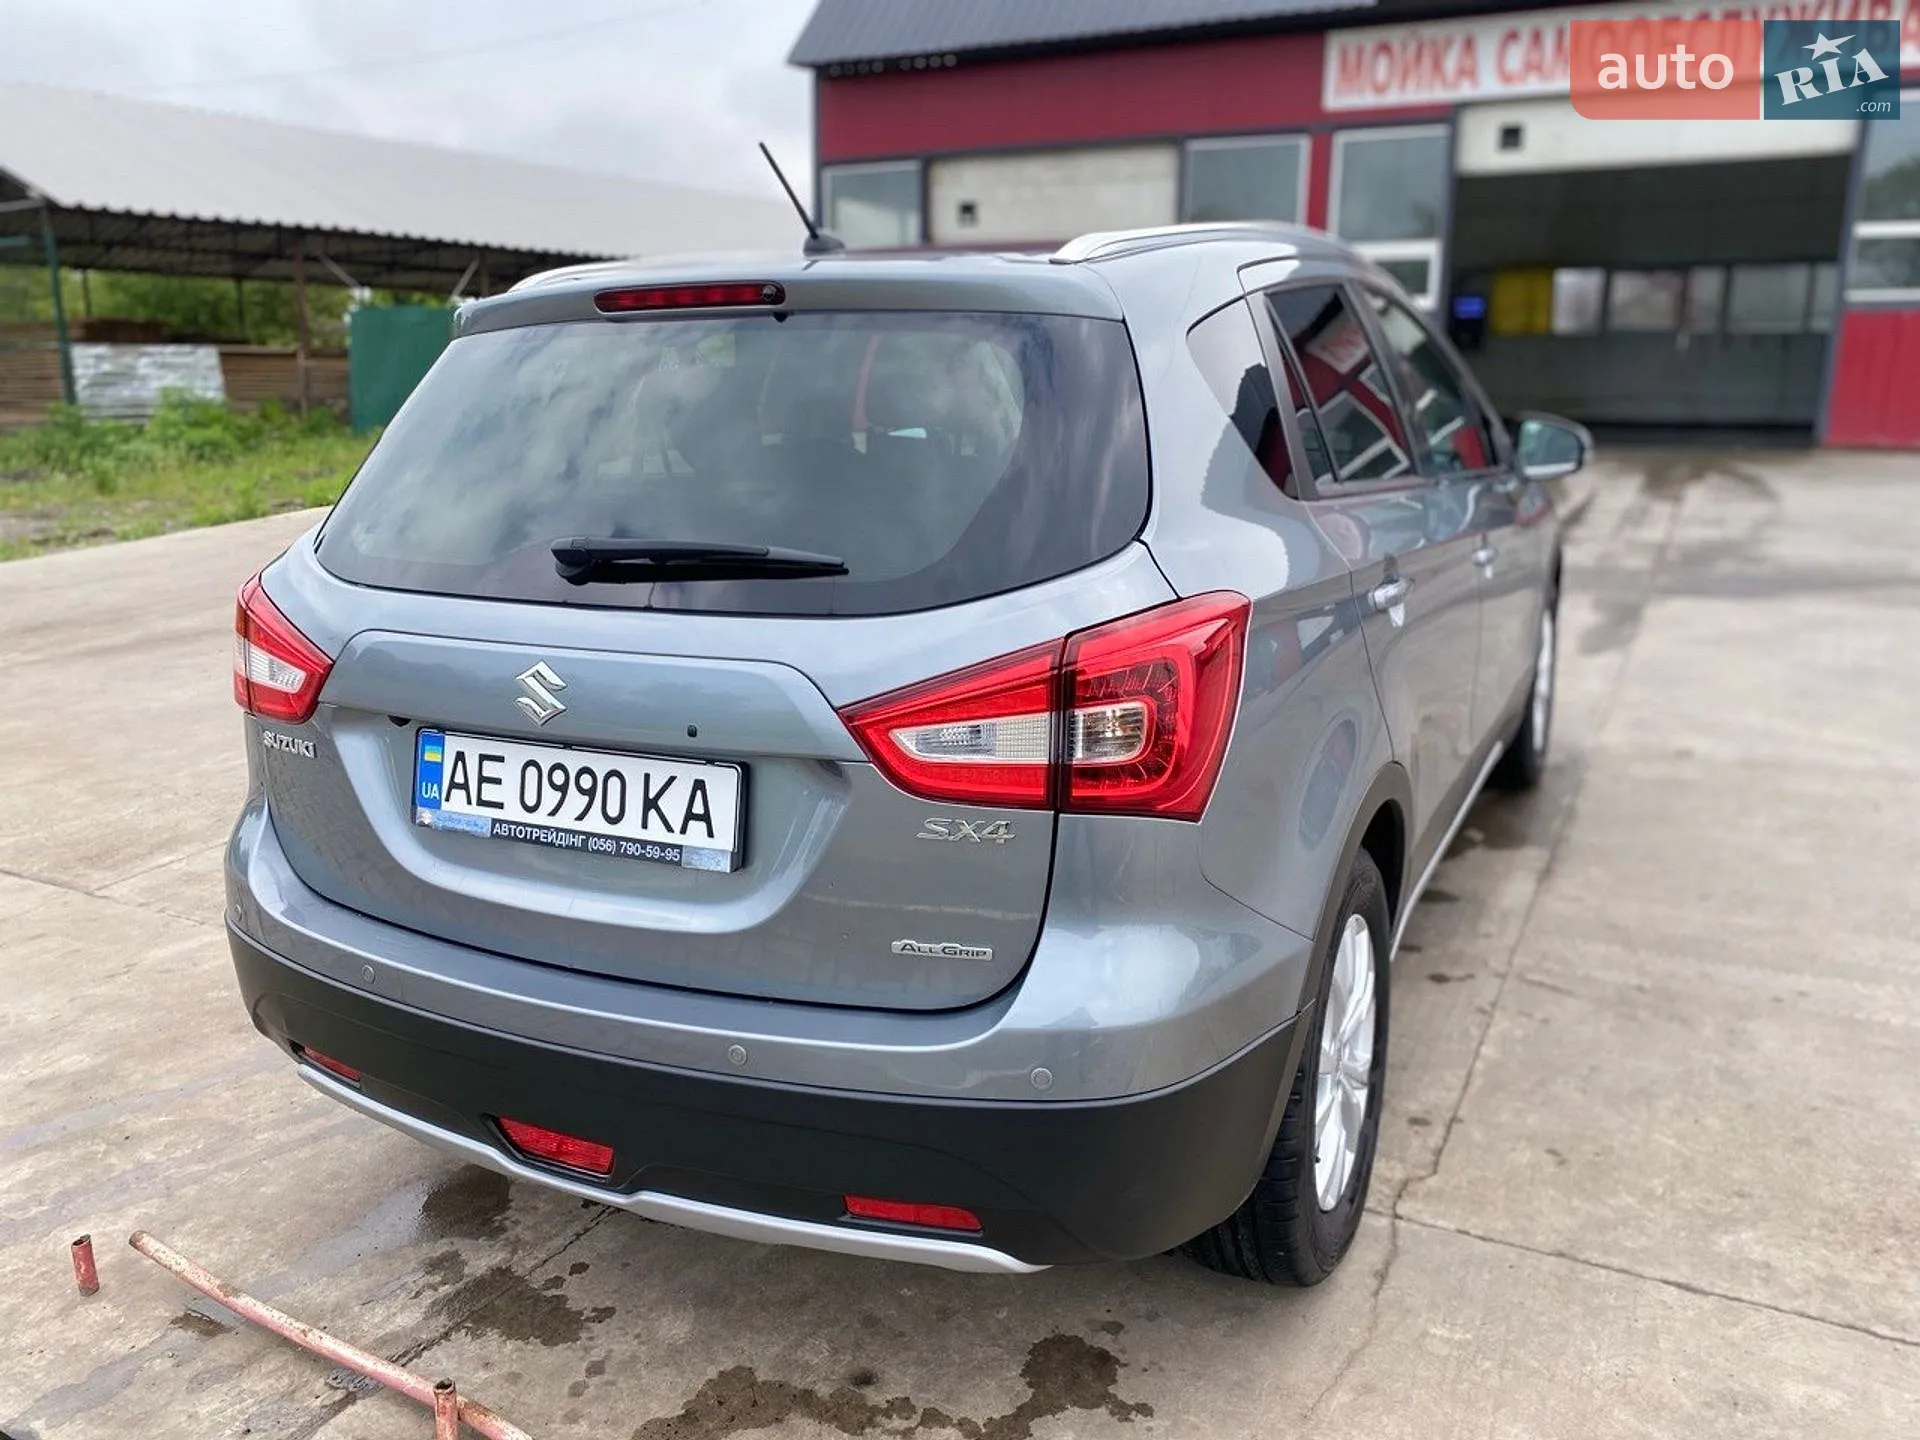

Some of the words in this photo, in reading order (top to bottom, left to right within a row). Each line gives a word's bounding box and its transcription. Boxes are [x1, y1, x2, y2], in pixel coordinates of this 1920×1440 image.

[1338, 28, 1479, 97] МОЙКА
[263, 730, 317, 758] SUZUKI
[421, 781, 440, 800] UA
[444, 750, 505, 810] AE
[518, 758, 627, 826] 0990
[640, 772, 715, 839] KA
[492, 822, 586, 848] АВТОТРЕЙДІНГ
[587, 837, 617, 855] (056)
[619, 841, 681, 862] 790-59-95
[916, 817, 1017, 844] SX4
